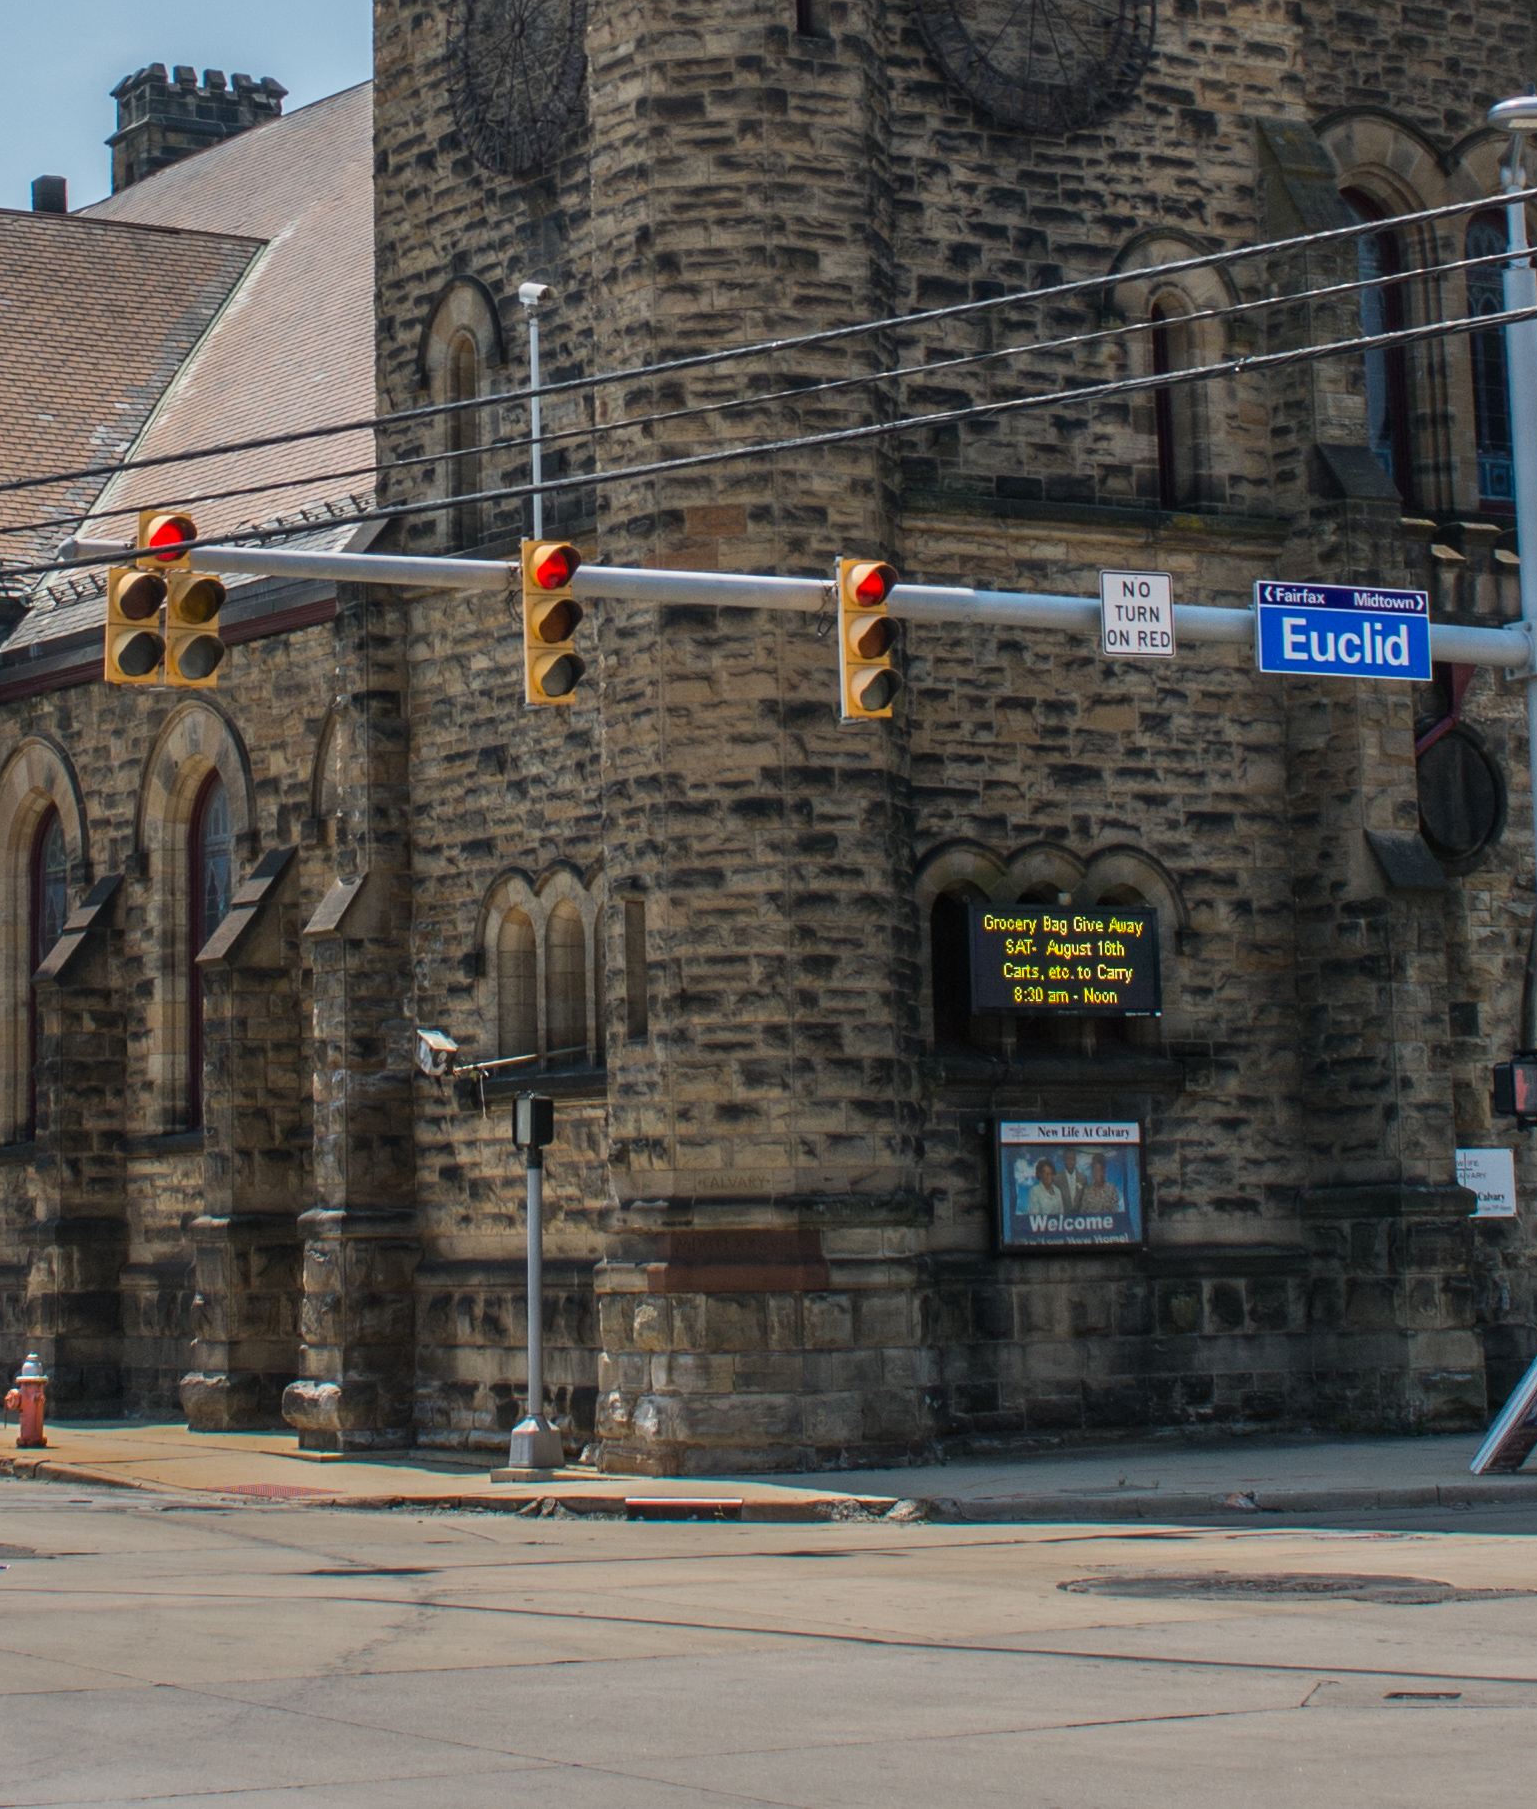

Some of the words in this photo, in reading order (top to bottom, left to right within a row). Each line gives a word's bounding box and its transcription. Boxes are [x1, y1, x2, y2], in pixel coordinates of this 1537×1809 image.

[1122, 581, 1151, 598] NO
[1276, 587, 1326, 605] Fairfax
[1353, 592, 1414, 610] Midtown
[1115, 604, 1160, 623] TURN
[1106, 629, 1131, 647] ON
[1138, 630, 1171, 648] RED
[1281, 616, 1410, 667] Euclid
[984, 914, 1037, 936] Grocery
[1043, 915, 1068, 936] Bag
[1073, 916, 1104, 932] Give
[1108, 917, 1144, 938] Away
[1046, 940, 1092, 959] August
[1003, 962, 1046, 982] Carts,
[1048, 965, 1075, 980] etc.
[1077, 965, 1092, 980] to
[1097, 964, 1134, 984] Carry
[1014, 986, 1044, 1004] 8:30
[1047, 990, 1070, 1004] am
[1083, 988, 1118, 1004] Noon
[1037, 1126, 1059, 1138] New
[1061, 1126, 1079, 1138] Life
[1081, 1126, 1093, 1138] At
[1095, 1126, 1130, 1140] Calvary
[701, 1175, 766, 1189] CALVARY
[1478, 1191, 1505, 1203] Calvary
[1028, 1213, 1114, 1232] Welcome
[1093, 1232, 1129, 1244] Home!
